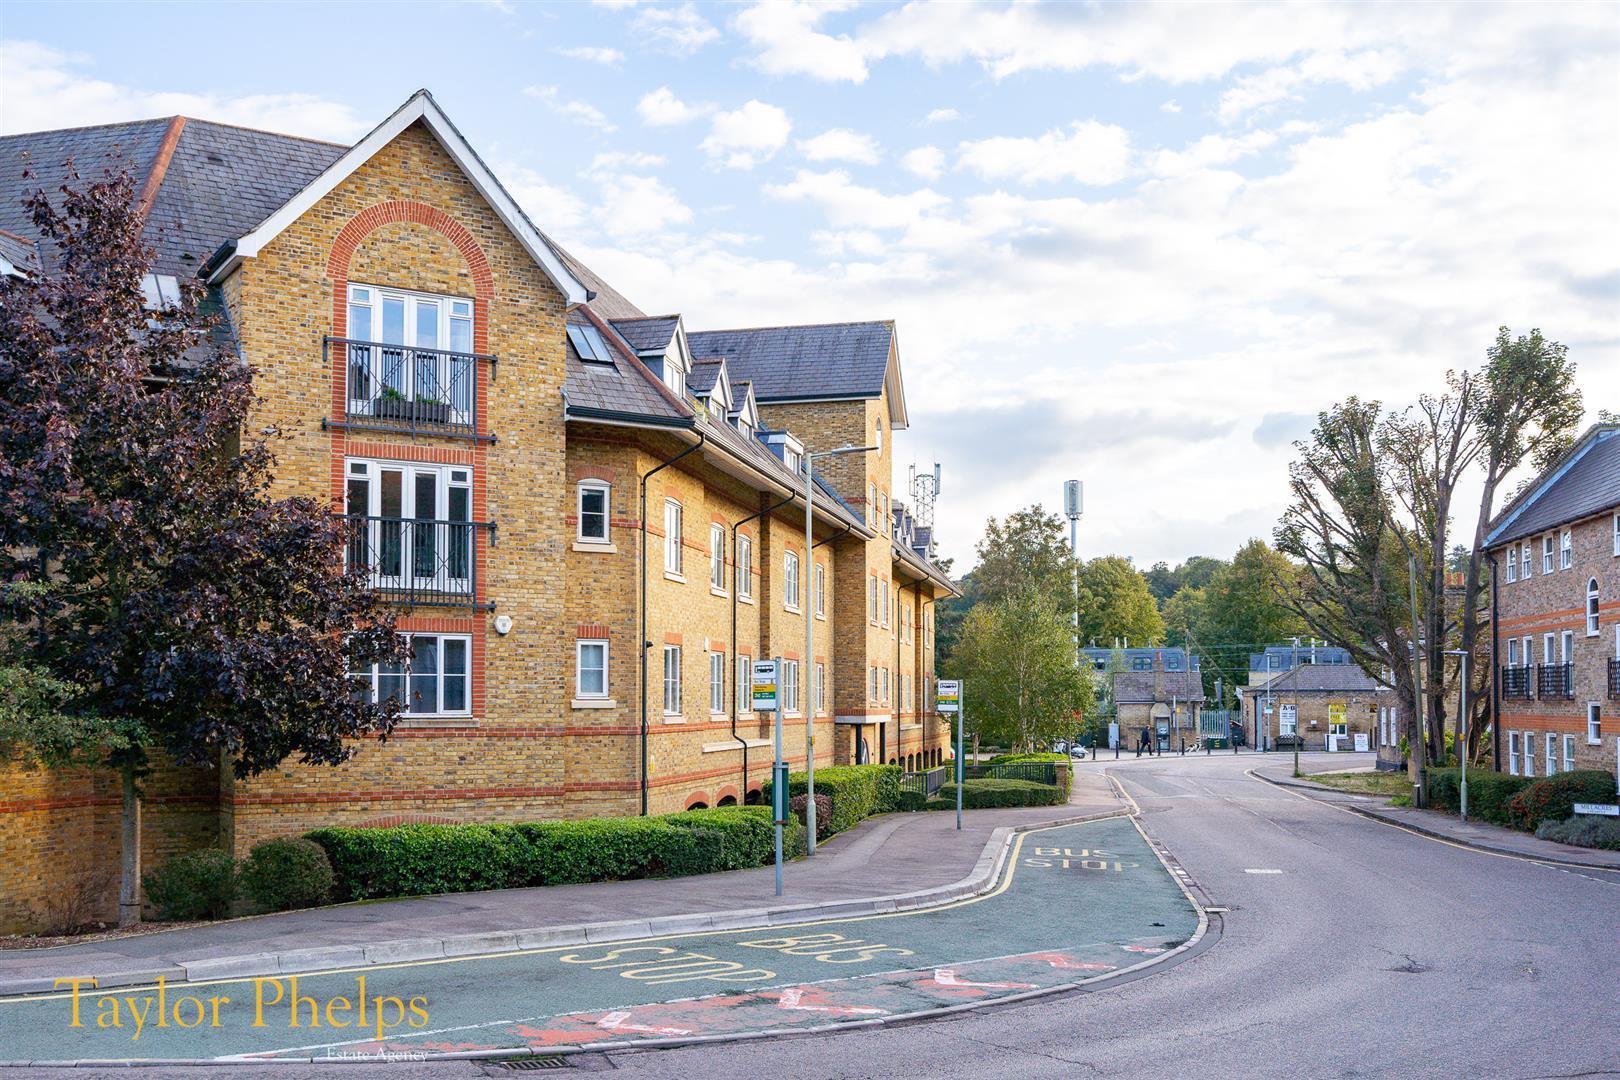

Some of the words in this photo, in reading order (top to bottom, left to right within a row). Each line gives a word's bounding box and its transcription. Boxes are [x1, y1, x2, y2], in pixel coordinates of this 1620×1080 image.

[1034, 847, 1120, 859] BUS
[1023, 858, 1140, 872] STOP
[736, 933, 915, 964] BUS
[559, 946, 777, 985] STOP
